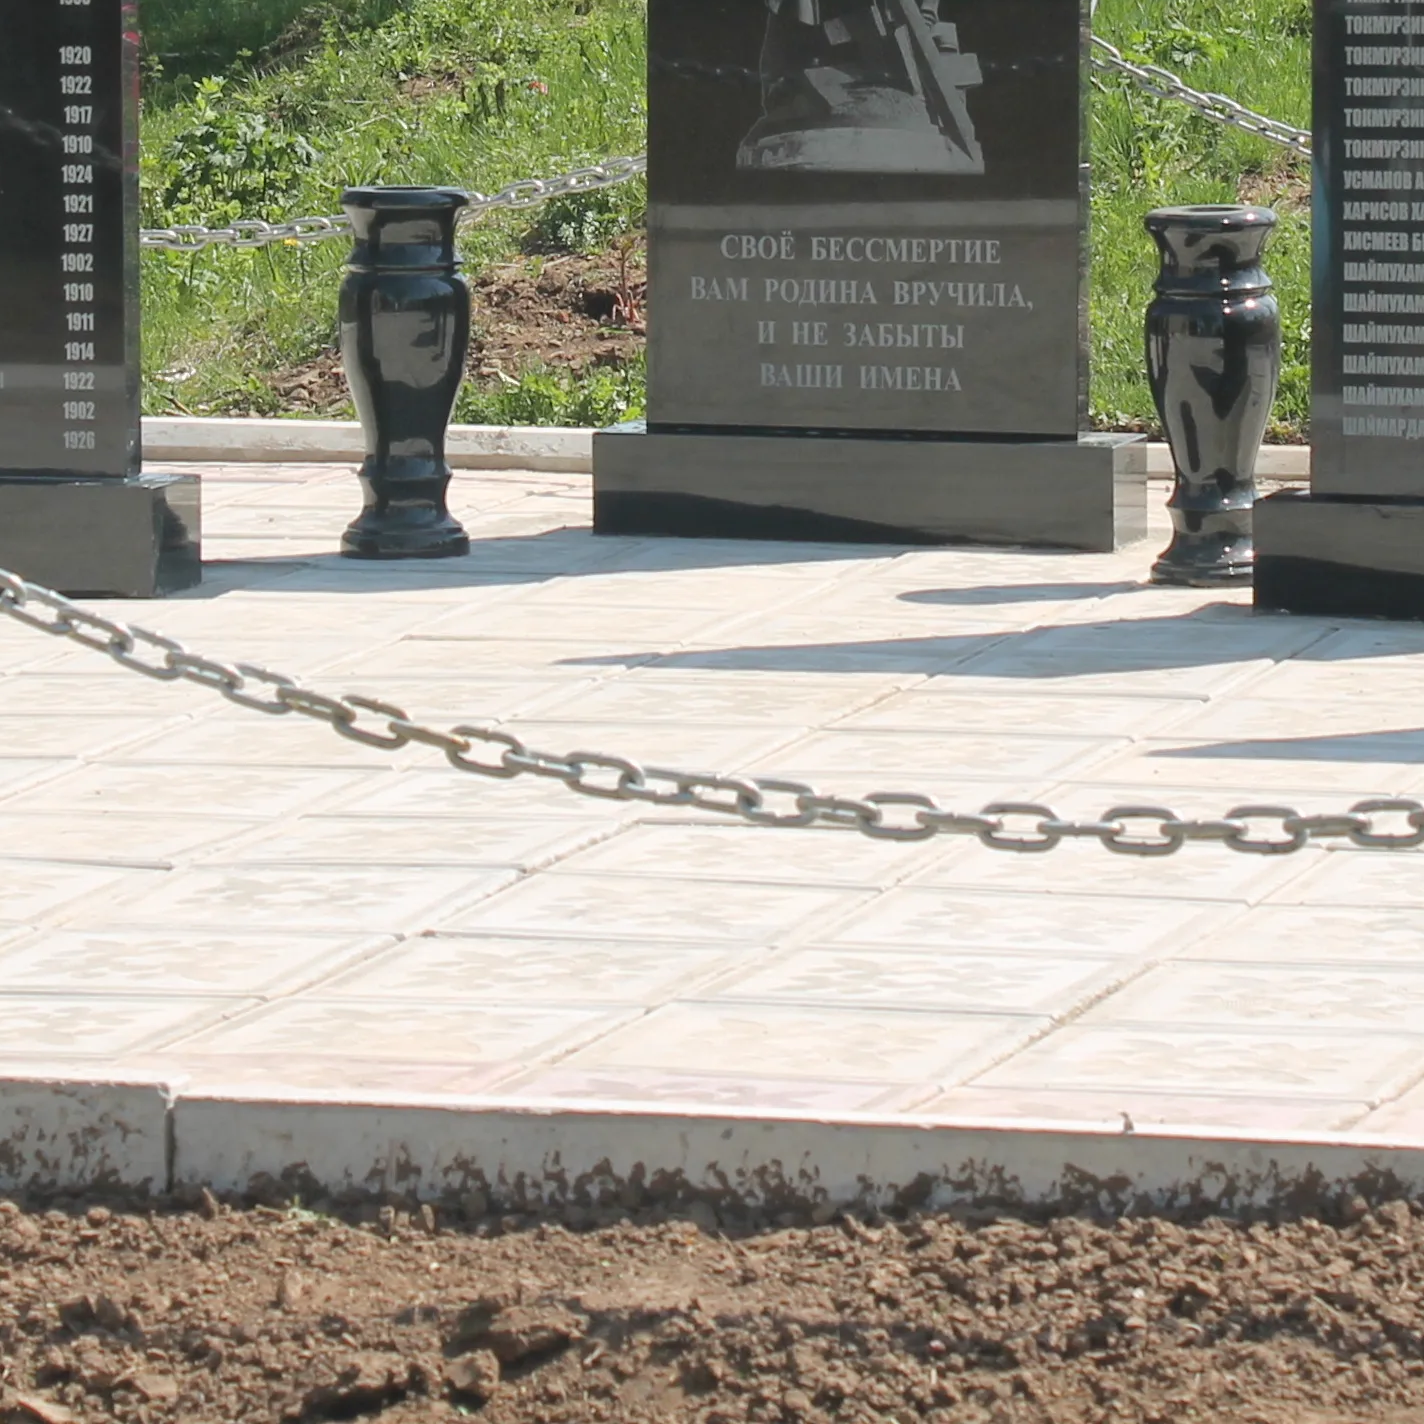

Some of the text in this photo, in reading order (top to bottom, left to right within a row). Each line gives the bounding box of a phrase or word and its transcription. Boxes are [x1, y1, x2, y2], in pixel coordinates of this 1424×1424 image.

[60, 75, 91, 94] 1922
[63, 194, 93, 213] 1921
[720, 231, 1000, 264] СВОЁ БЕССМЕРТИЕ
[64, 283, 93, 301] 1910
[691, 277, 1033, 310] ВАМ РОДИНА ВРУЧИЛА,
[757, 321, 964, 349] И НЕ ЗАБЫТЫ
[761, 364, 963, 391] ВАШИ ИМЕНА
